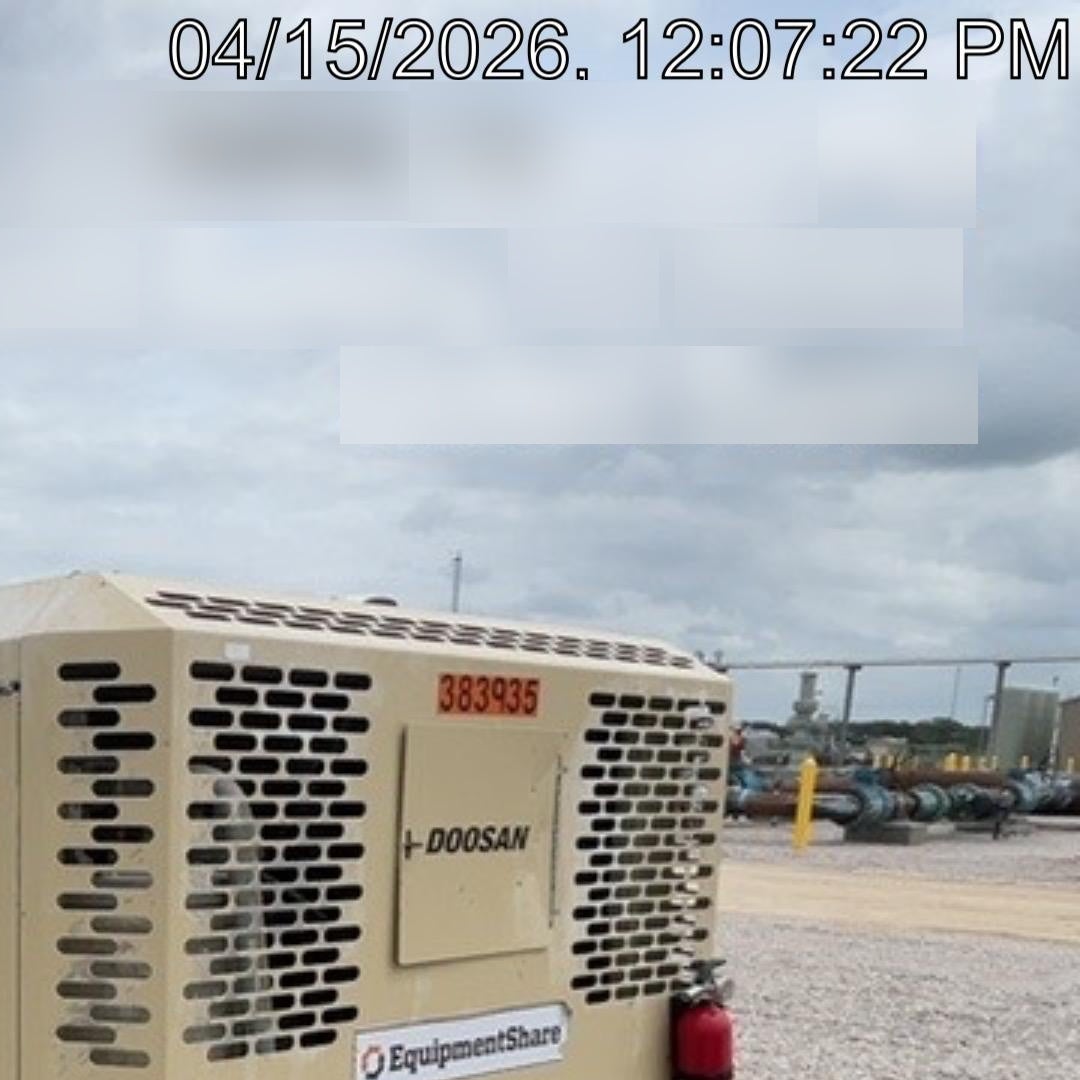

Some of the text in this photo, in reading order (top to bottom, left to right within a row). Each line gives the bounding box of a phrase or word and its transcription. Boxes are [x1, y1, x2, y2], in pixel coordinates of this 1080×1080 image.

[439, 674, 538, 714] 383935
[426, 825, 529, 853] DOOSAN
[389, 1024, 562, 1074] EquipmentShare
